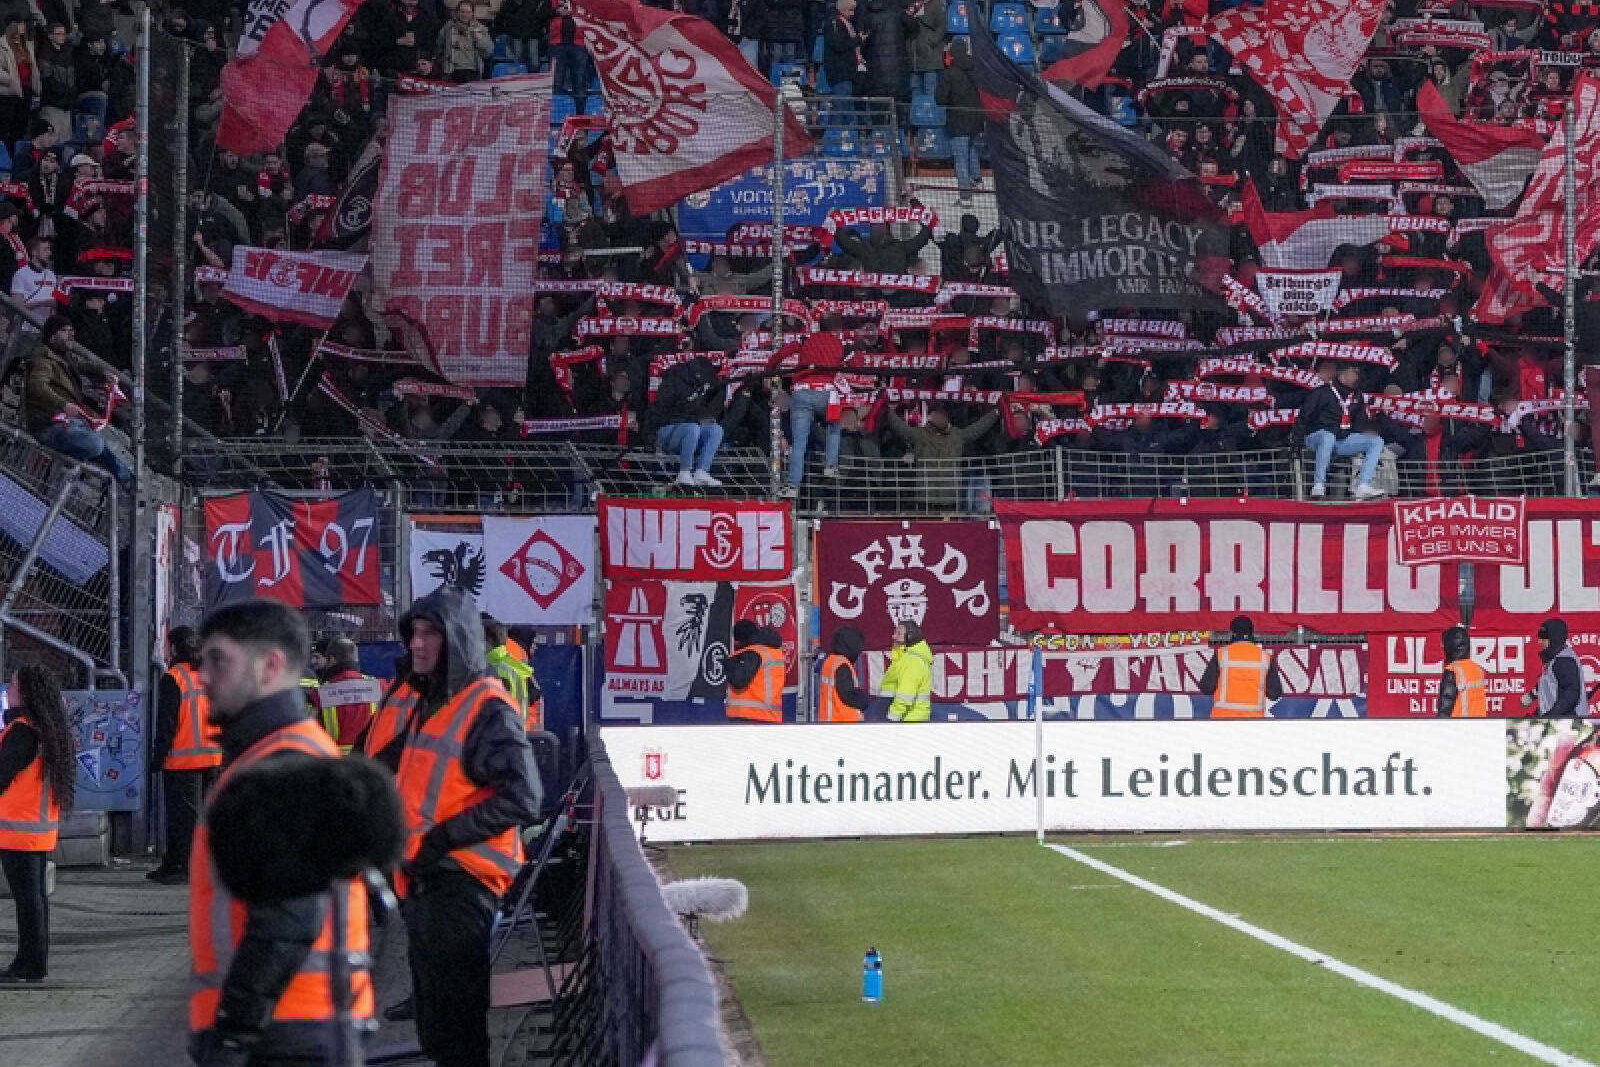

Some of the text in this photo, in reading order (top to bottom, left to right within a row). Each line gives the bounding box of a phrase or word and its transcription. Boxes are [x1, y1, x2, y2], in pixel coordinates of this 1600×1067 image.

[1082, 212, 1203, 257] LEGACY
[1403, 502, 1518, 524] KHALID
[1404, 524, 1518, 541] FÜR IMMER
[1420, 540, 1500, 555] BEI UNS
[1019, 520, 1441, 615] CORRILLO
[745, 752, 1434, 804] Miteinander. Mit Leidenschaft.
